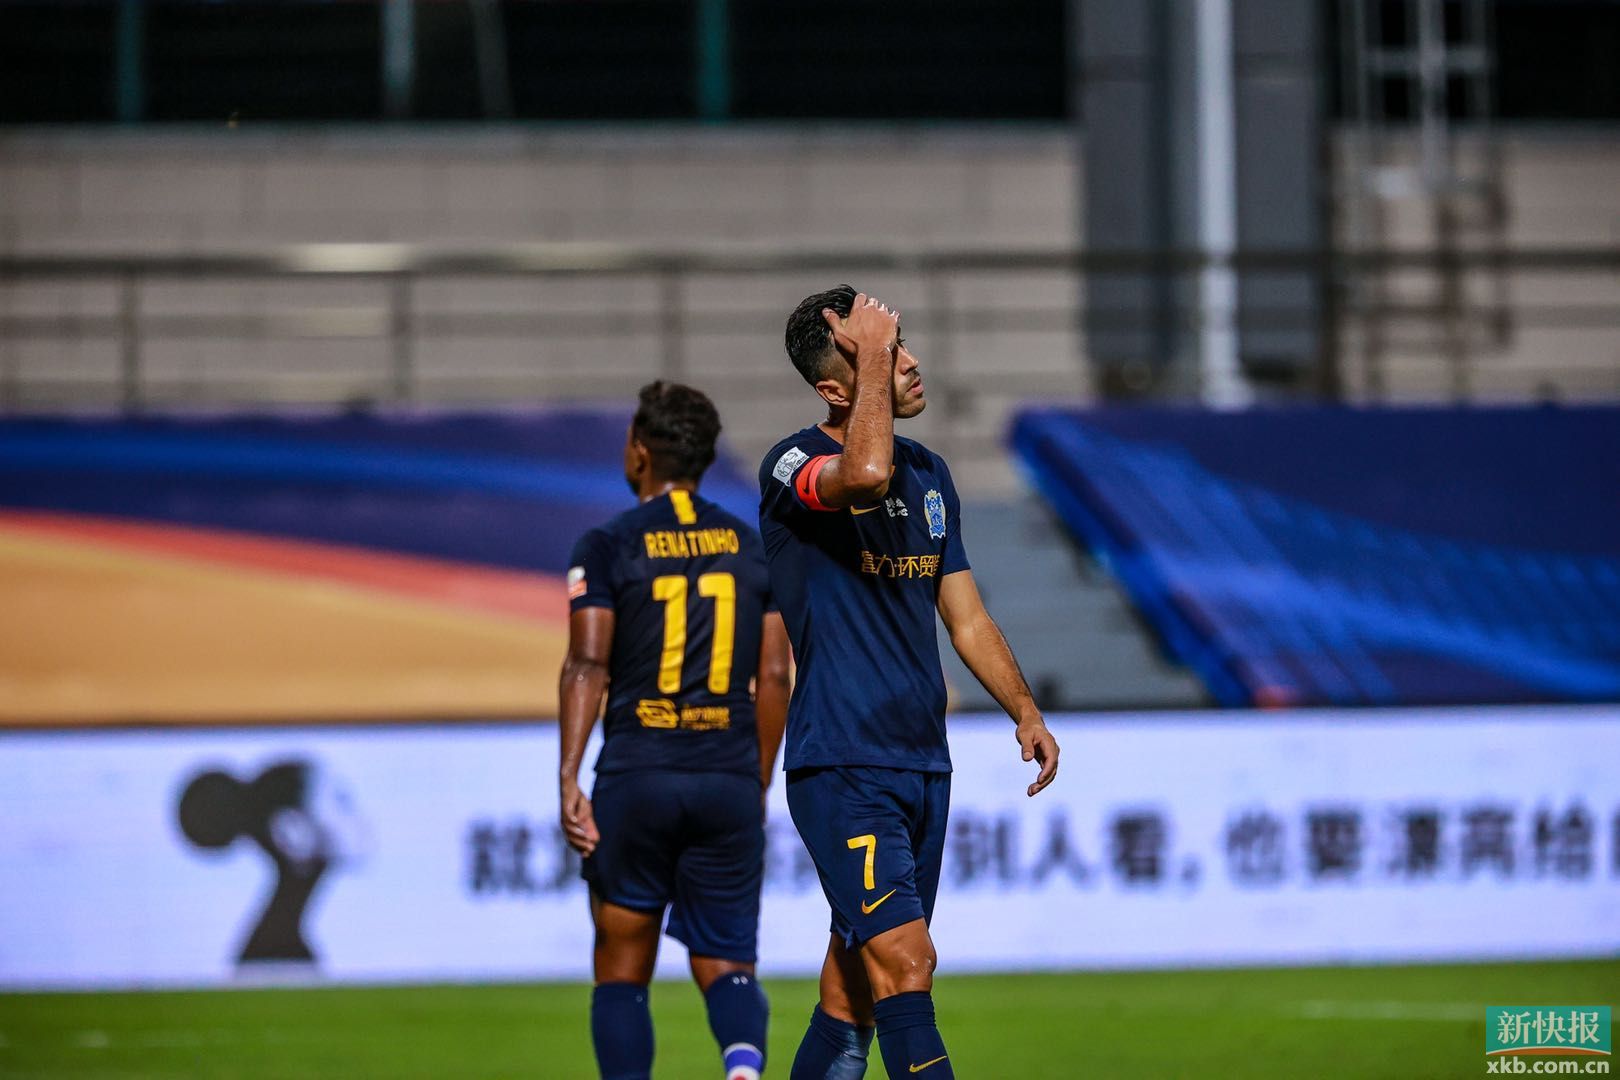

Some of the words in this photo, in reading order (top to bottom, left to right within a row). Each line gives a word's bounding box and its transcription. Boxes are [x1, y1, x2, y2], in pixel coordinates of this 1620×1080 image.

[644, 528, 740, 558] RENATINHO
[652, 571, 736, 695] 11
[846, 834, 877, 891] 7
